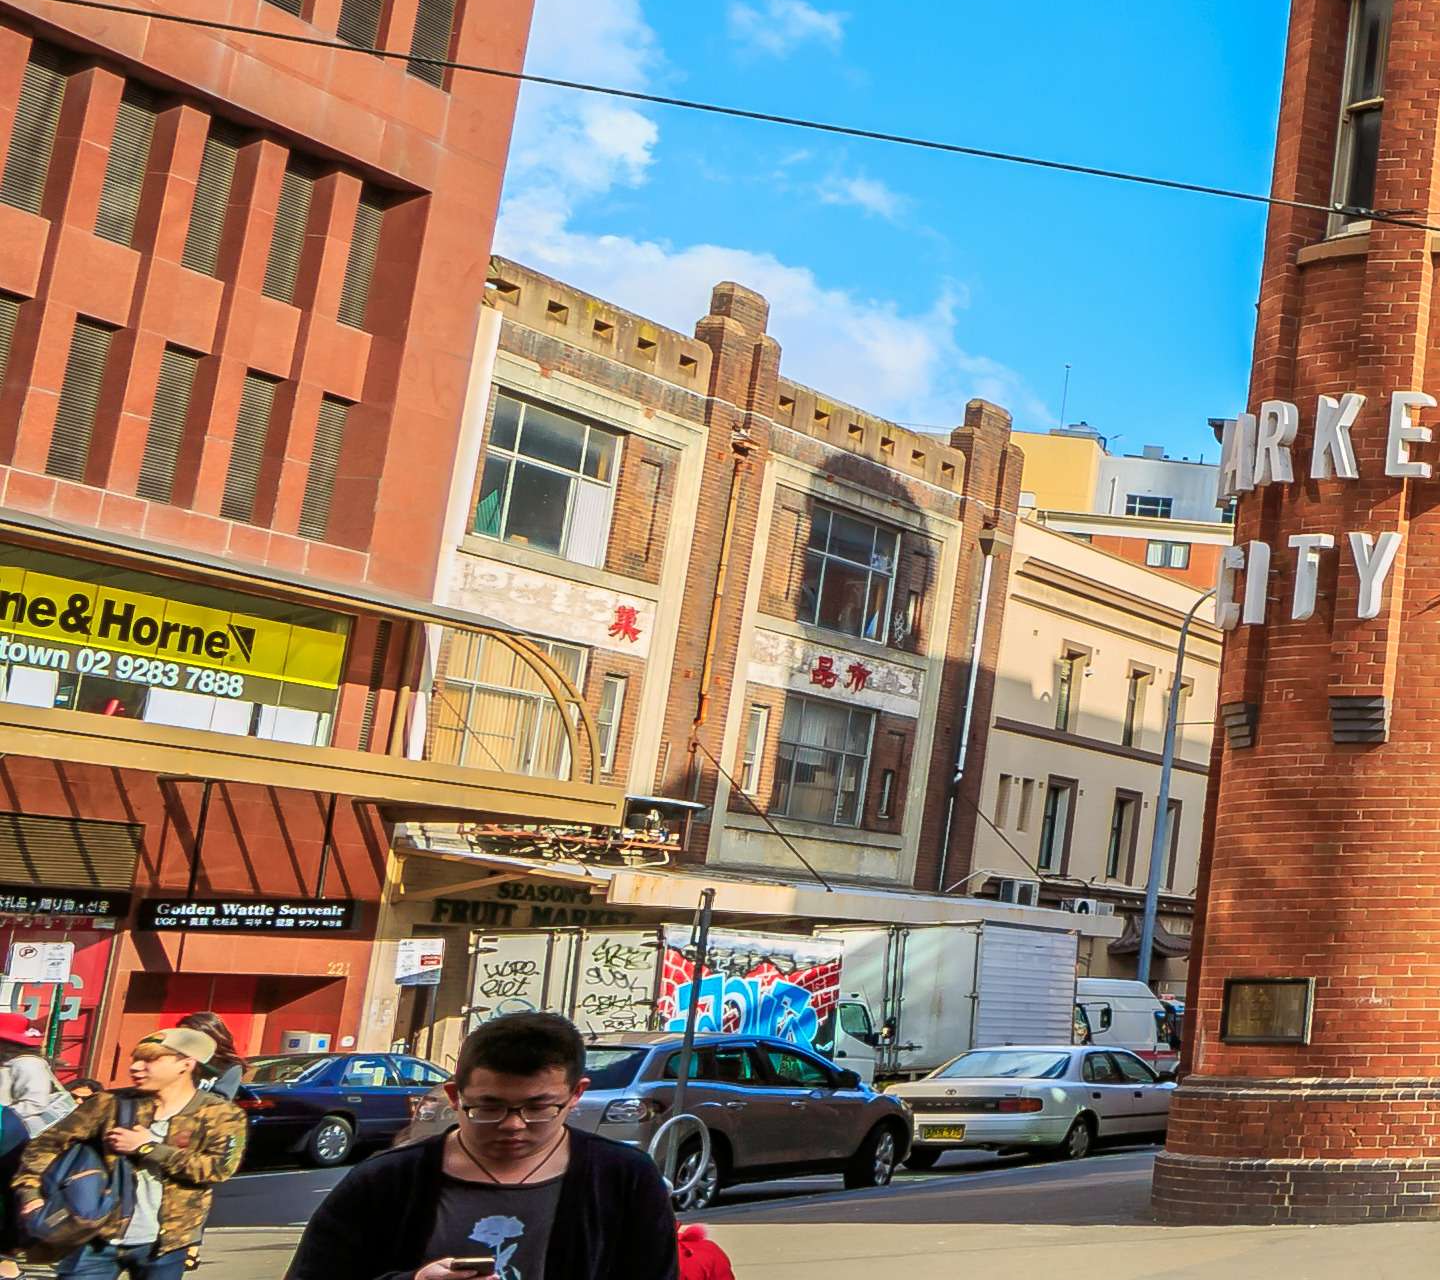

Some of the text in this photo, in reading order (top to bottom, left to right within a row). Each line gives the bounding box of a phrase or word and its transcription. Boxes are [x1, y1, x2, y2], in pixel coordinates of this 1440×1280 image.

[1214, 531, 1404, 631] CITY
[77, 648, 109, 677] 02
[116, 655, 179, 688] 9283
[186, 666, 244, 699] 7888
[498, 882, 593, 905] SEASON'S
[154, 917, 177, 926] UGG
[156, 903, 346, 917] Golden Wattle Souvenir
[432, 898, 637, 928] FRUIT MARKET
